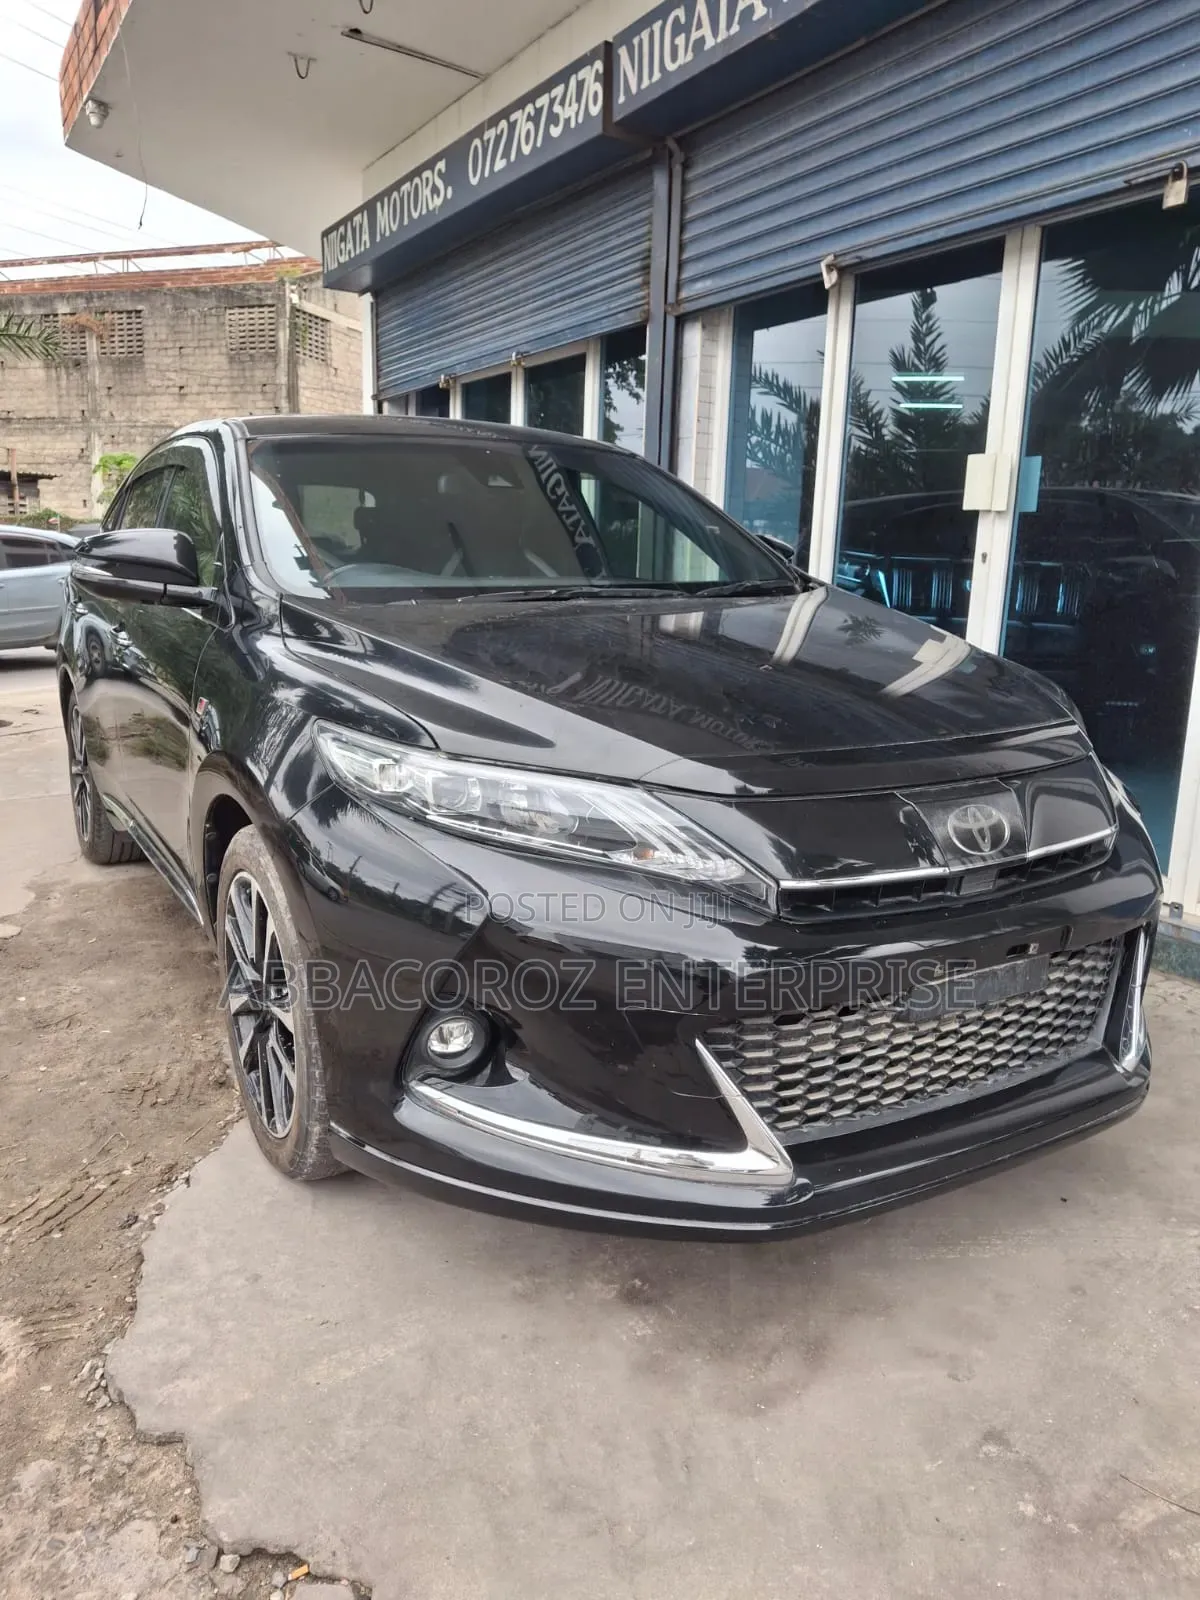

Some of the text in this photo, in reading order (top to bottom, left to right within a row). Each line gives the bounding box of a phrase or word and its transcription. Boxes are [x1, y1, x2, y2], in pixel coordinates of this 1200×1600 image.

[323, 60, 604, 274] NIIGATA MOTORS. 0727673476
